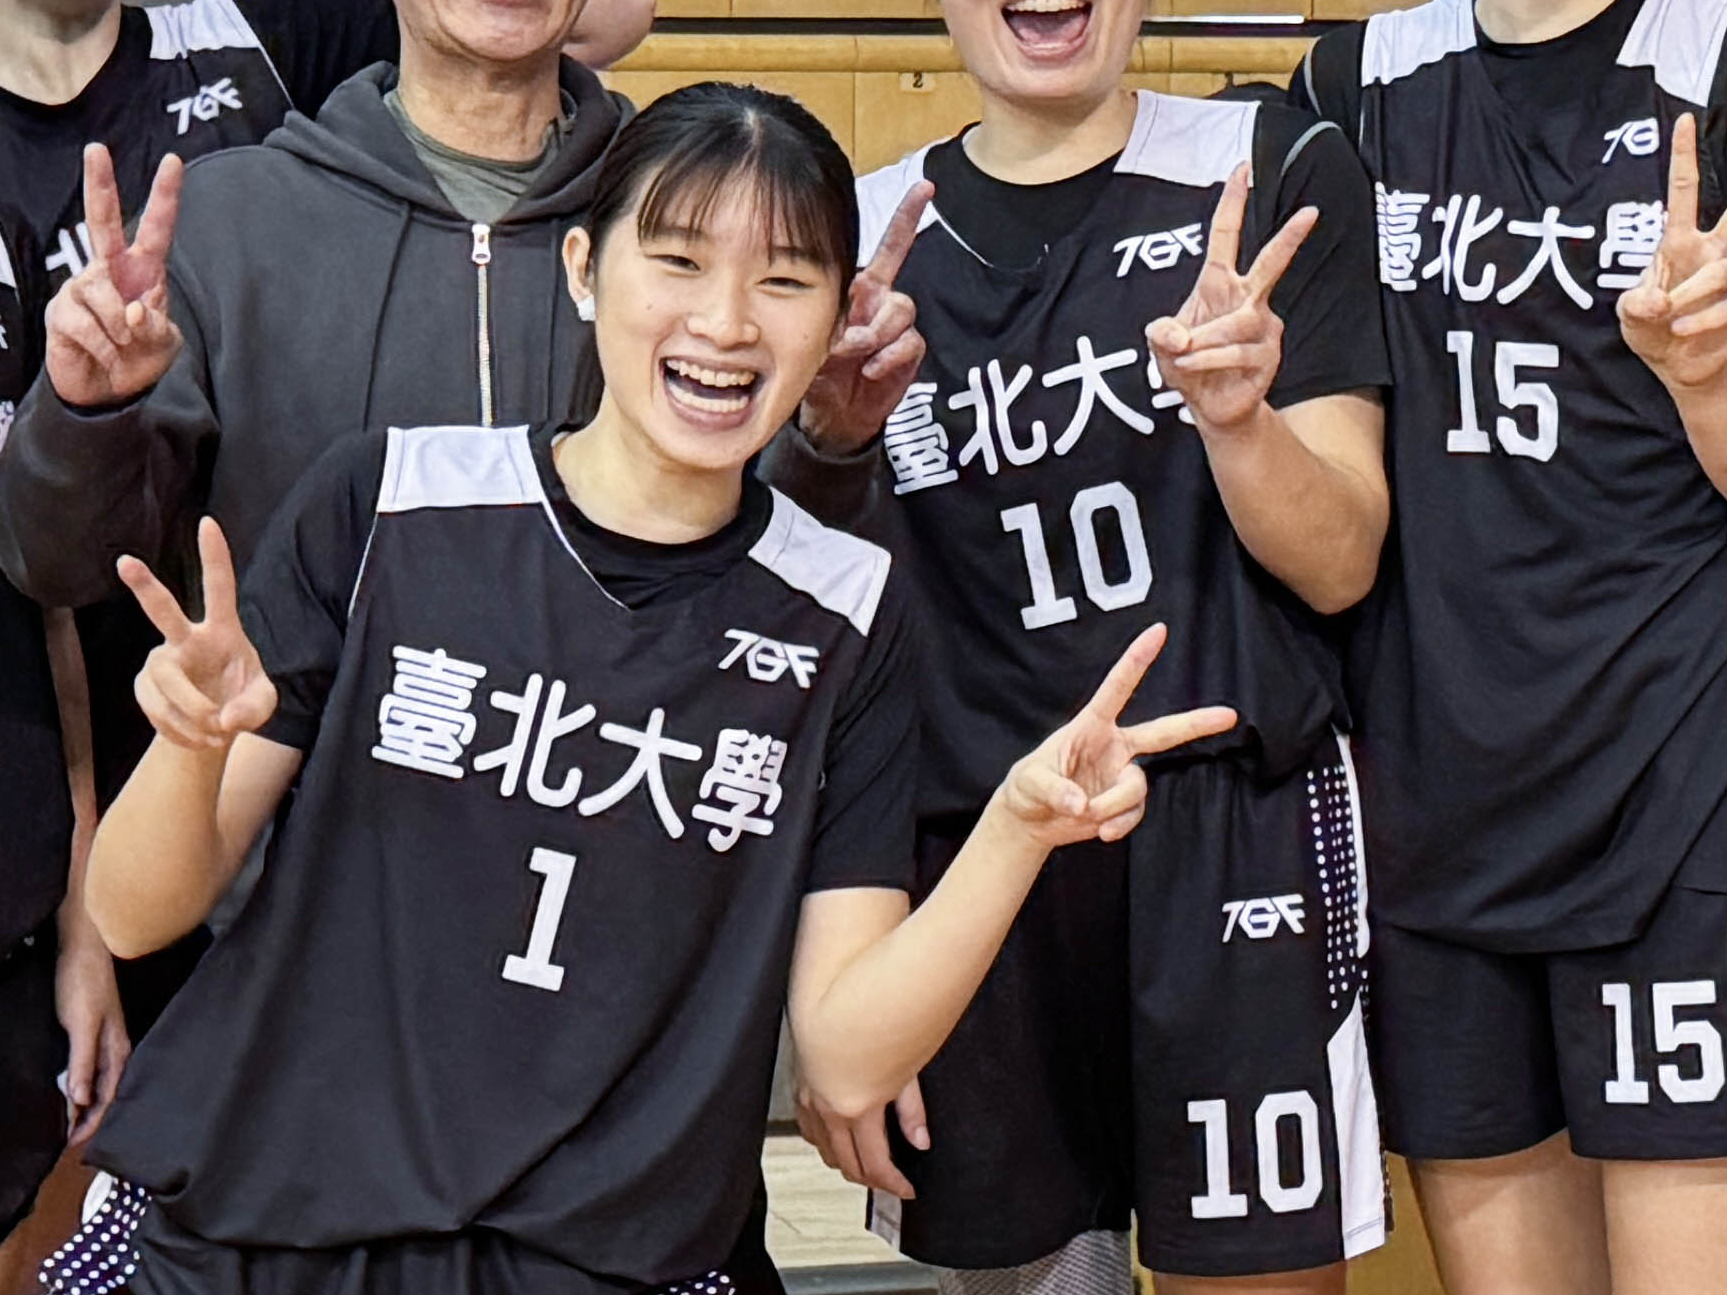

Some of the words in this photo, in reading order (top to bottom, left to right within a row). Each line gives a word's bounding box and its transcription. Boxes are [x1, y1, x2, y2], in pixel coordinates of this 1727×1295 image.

[912, 72, 925, 89] 2
[883, 335, 1196, 496] 臺北大
[1446, 330, 1560, 462] 15
[1001, 481, 1154, 630] 10
[371, 644, 789, 853] 臺北大學
[502, 846, 577, 992] 1
[1601, 979, 1726, 1105] 15
[1187, 1090, 1325, 1220] 10
